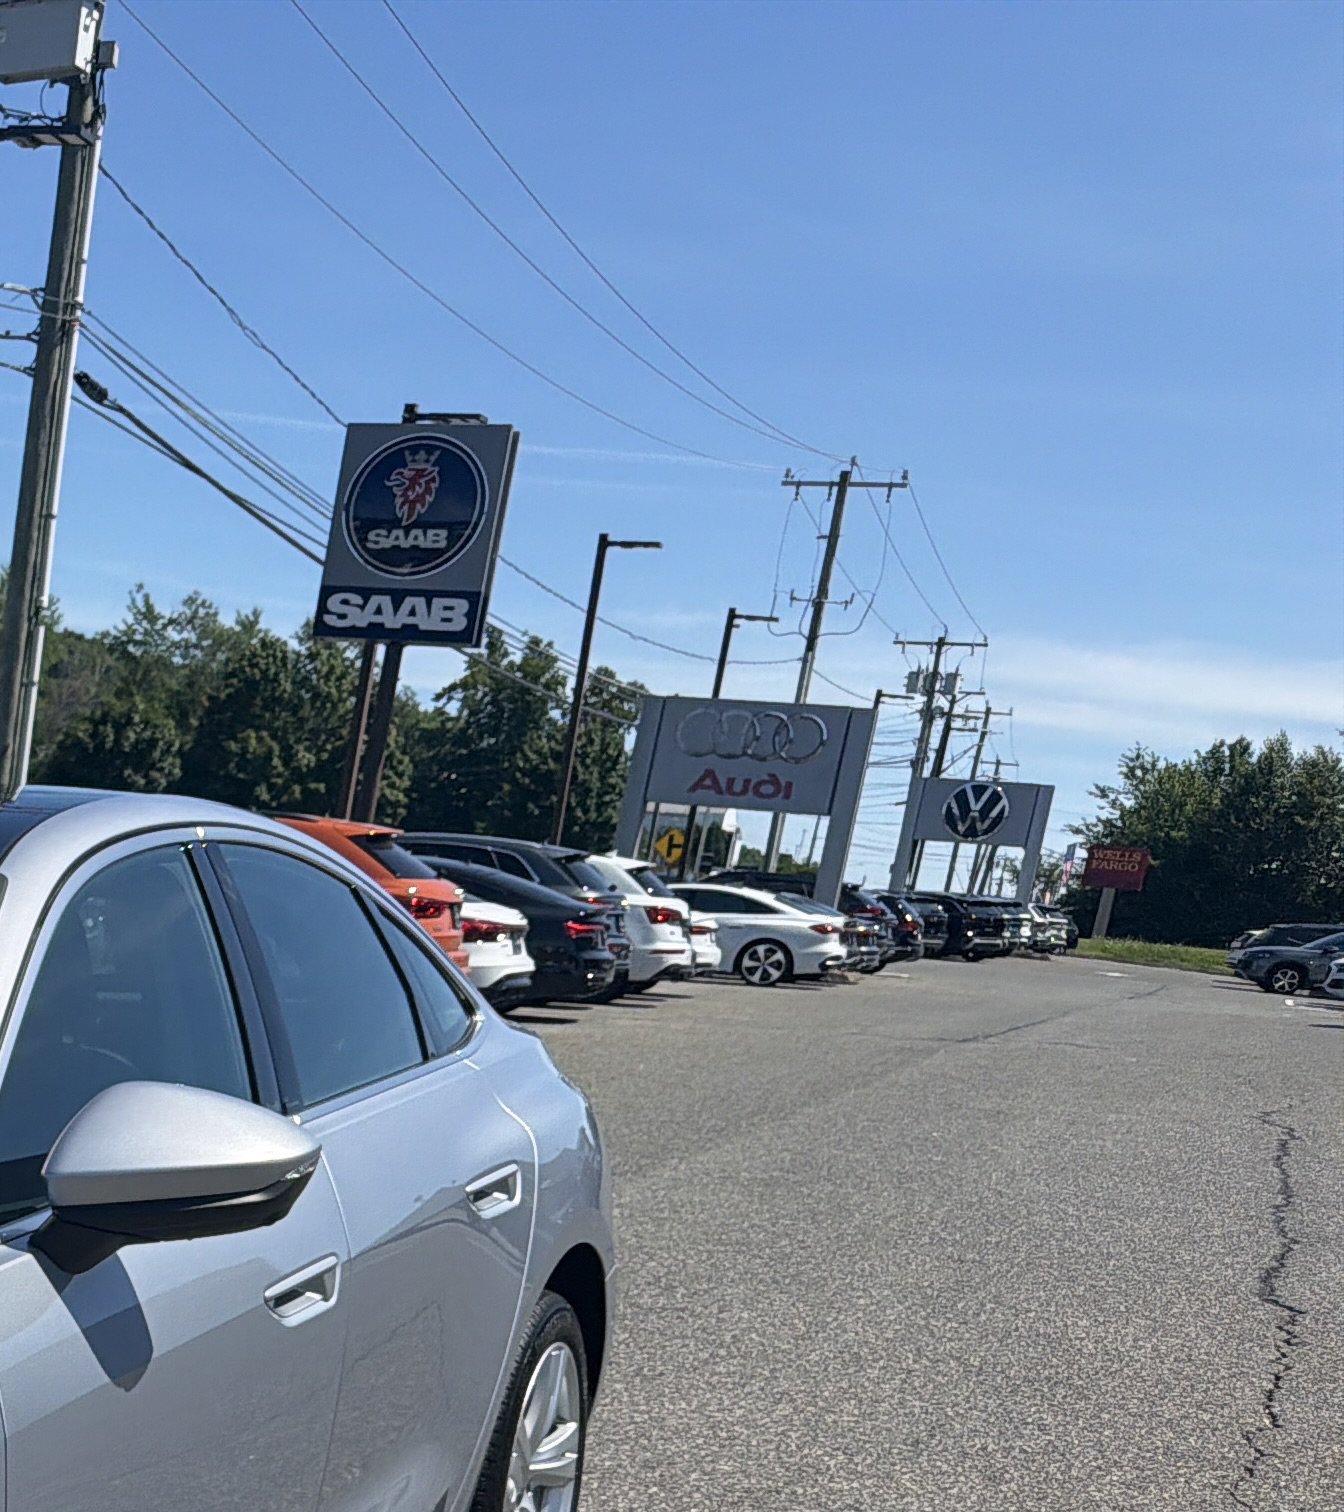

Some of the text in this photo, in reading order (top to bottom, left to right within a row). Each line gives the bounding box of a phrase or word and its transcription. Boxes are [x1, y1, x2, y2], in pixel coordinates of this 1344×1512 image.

[365, 528, 448, 549] SAAB
[322, 592, 470, 632] SAAB
[686, 767, 794, 801] Audi
[1090, 859, 1139, 872] FARGO
[1093, 848, 1142, 862] WELLS
